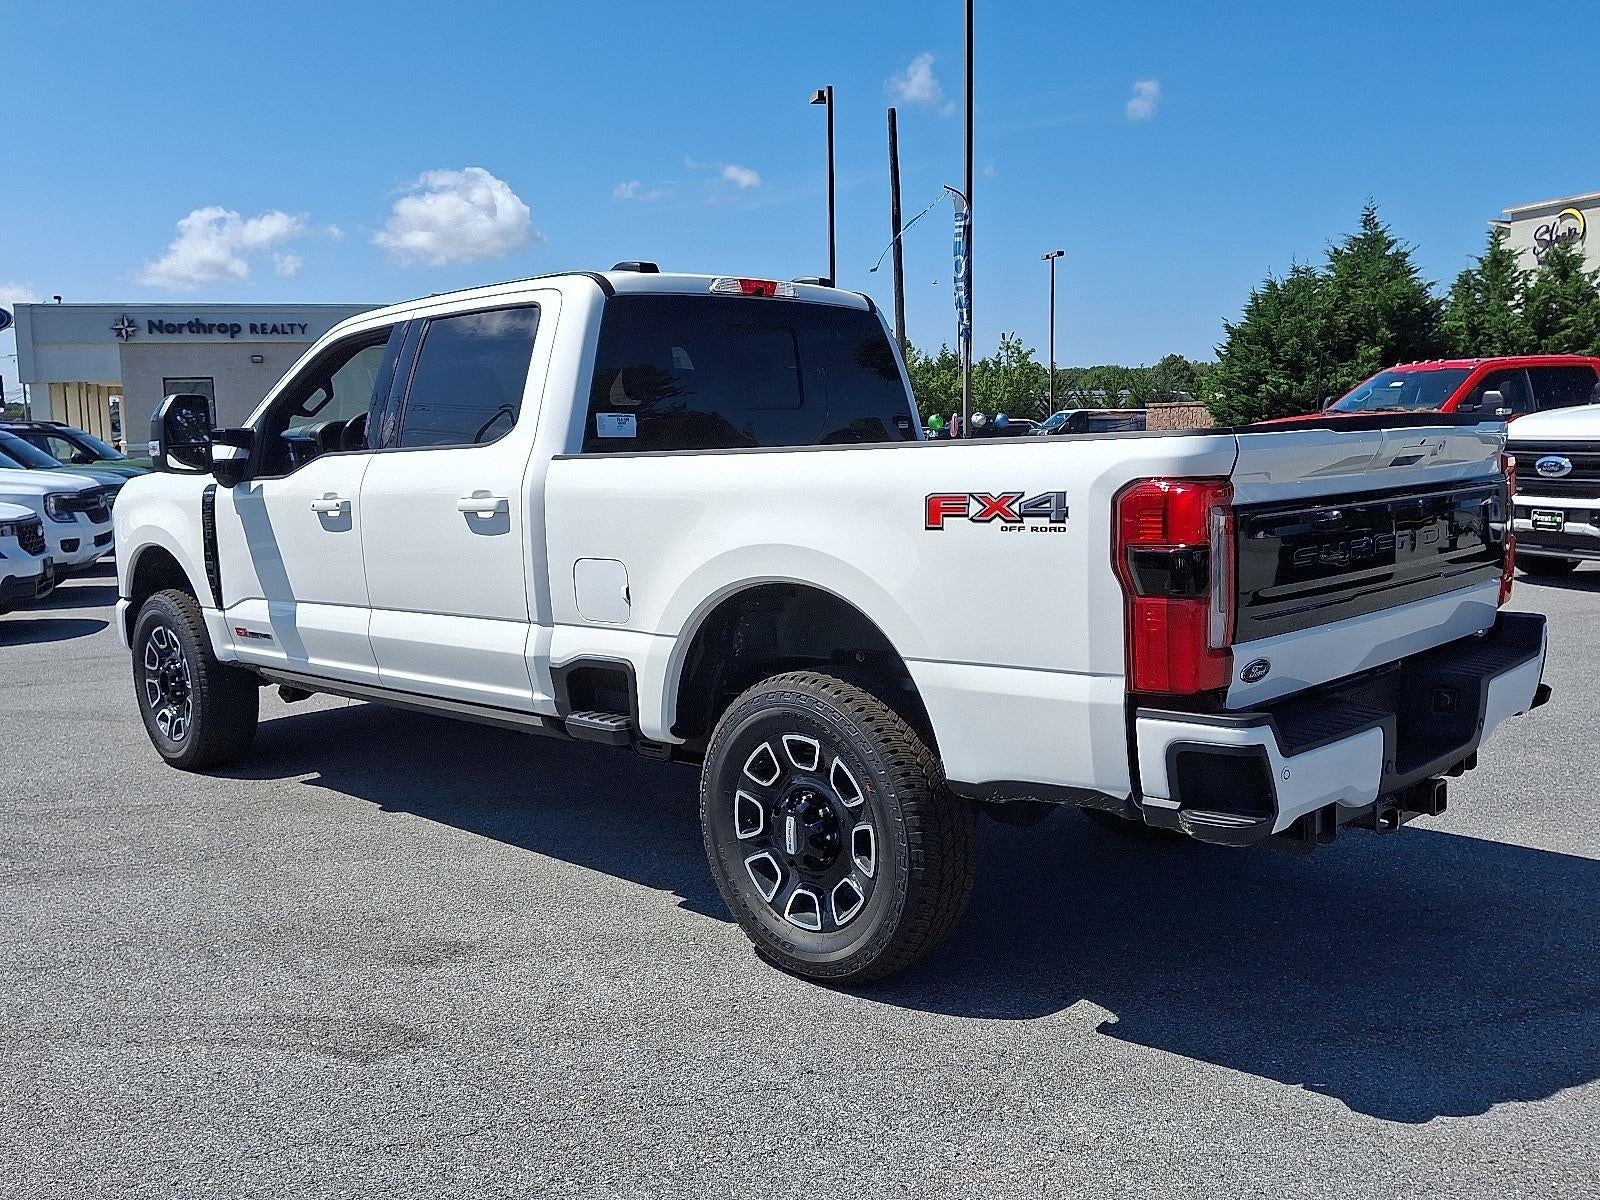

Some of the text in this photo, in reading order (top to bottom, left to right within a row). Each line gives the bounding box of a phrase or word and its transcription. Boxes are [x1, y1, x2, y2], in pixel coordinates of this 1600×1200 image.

[147, 317, 309, 339] Northrop REALTY
[925, 491, 1069, 531] FX4
[1000, 525, 1026, 533] OFF
[1248, 664, 1268, 680] Ford
